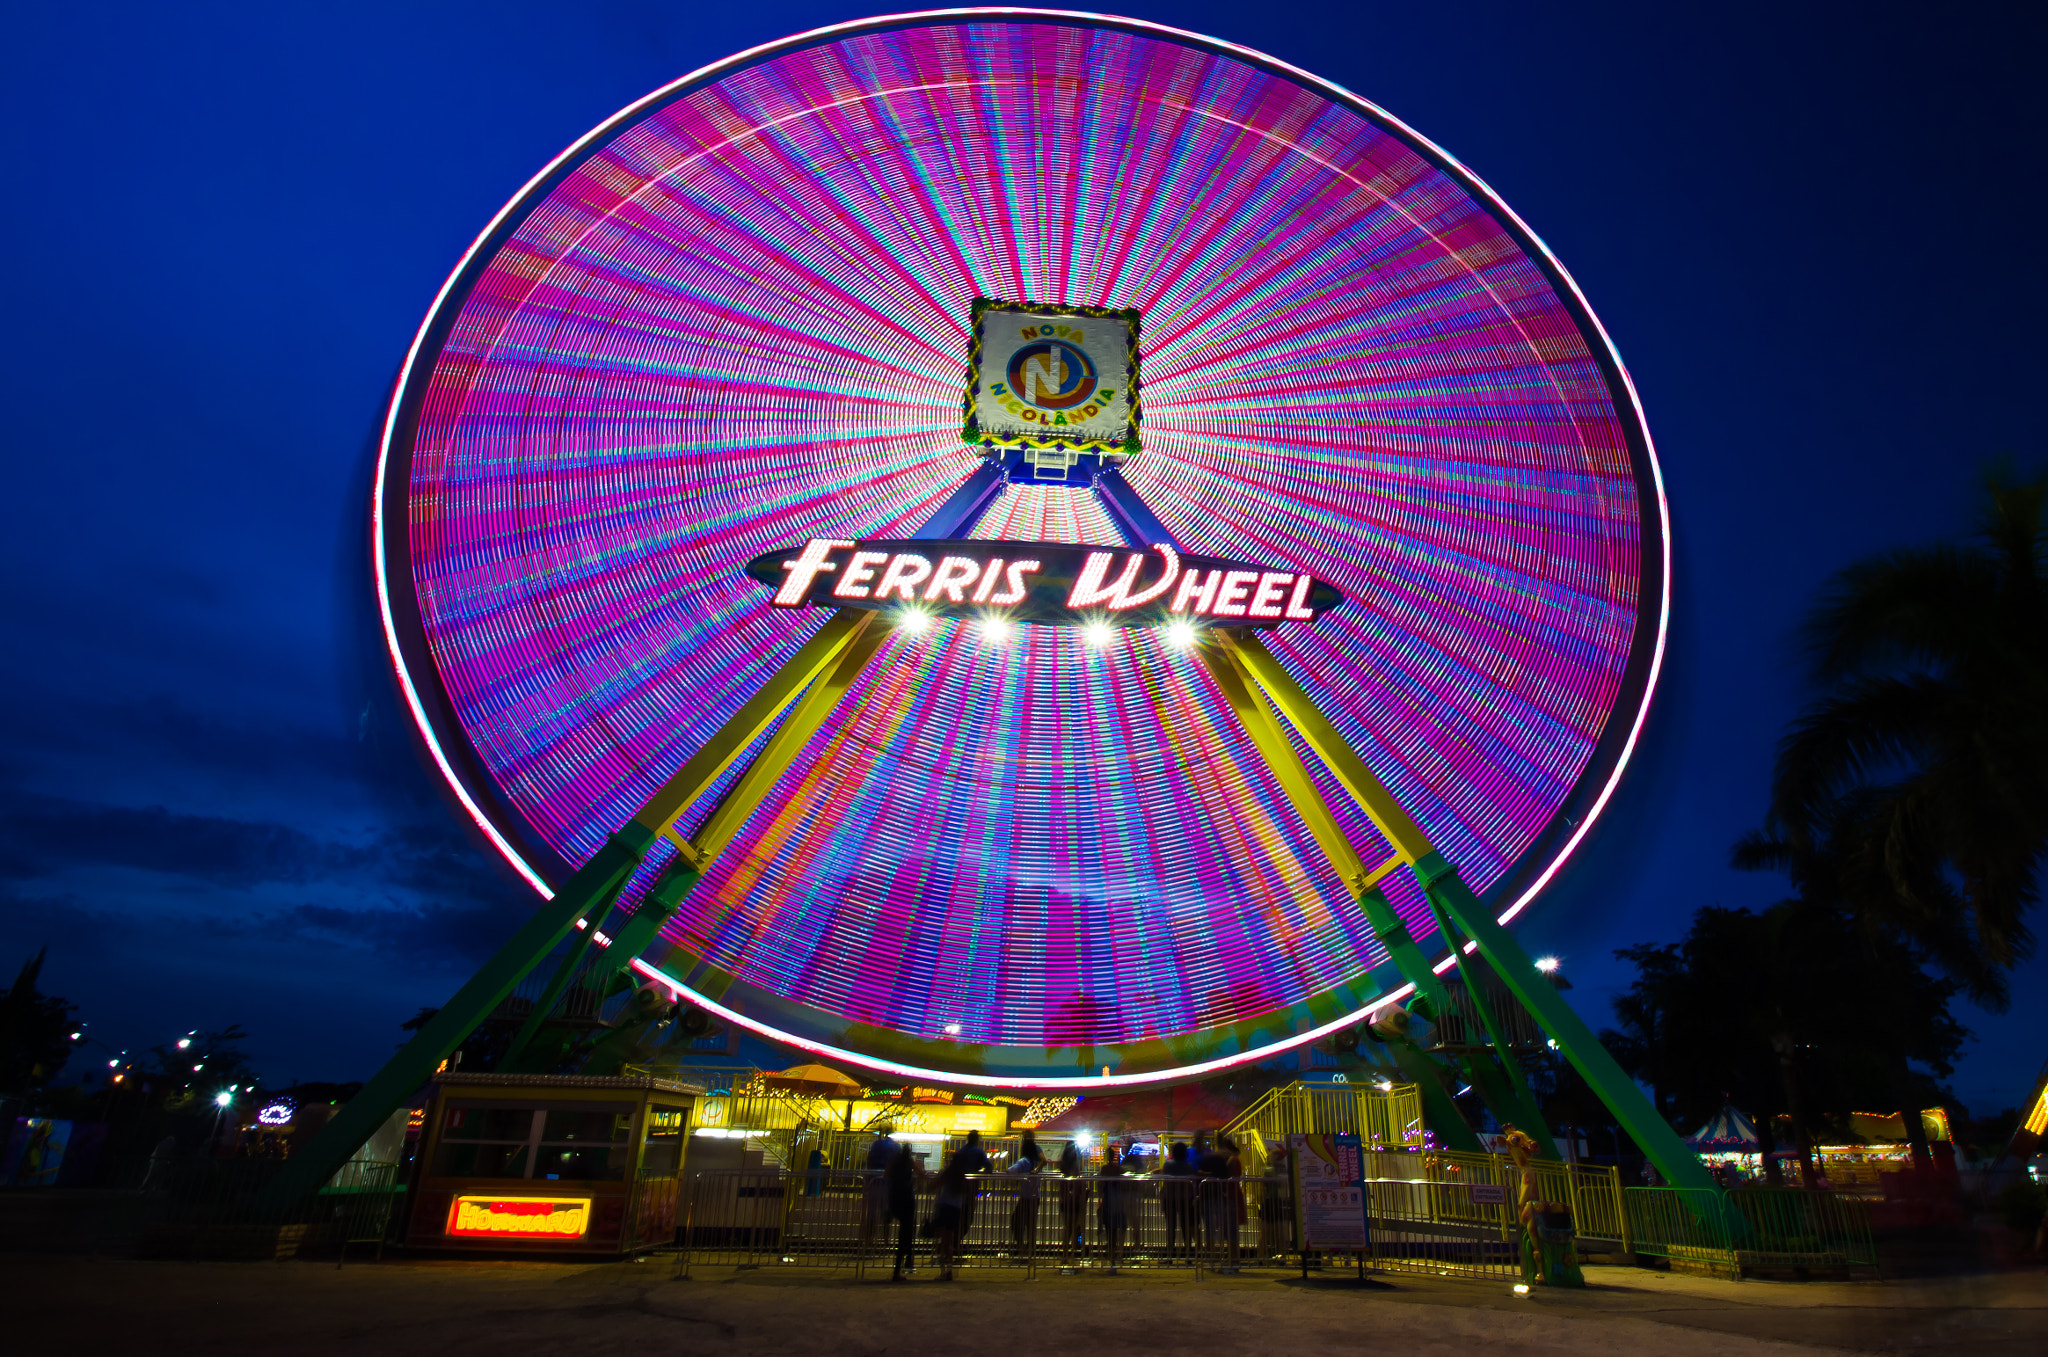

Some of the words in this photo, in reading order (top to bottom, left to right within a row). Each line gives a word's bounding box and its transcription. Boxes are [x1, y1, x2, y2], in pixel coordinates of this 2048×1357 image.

[1020, 324, 1084, 344] NOVA
[989, 382, 1116, 427] NICOLÂNDIA
[774, 538, 1041, 606] FERRIS
[1067, 543, 1314, 619] WHEEL
[1337, 1145, 1349, 1181] FERRIS
[1348, 1145, 1360, 1181] WHEEL
